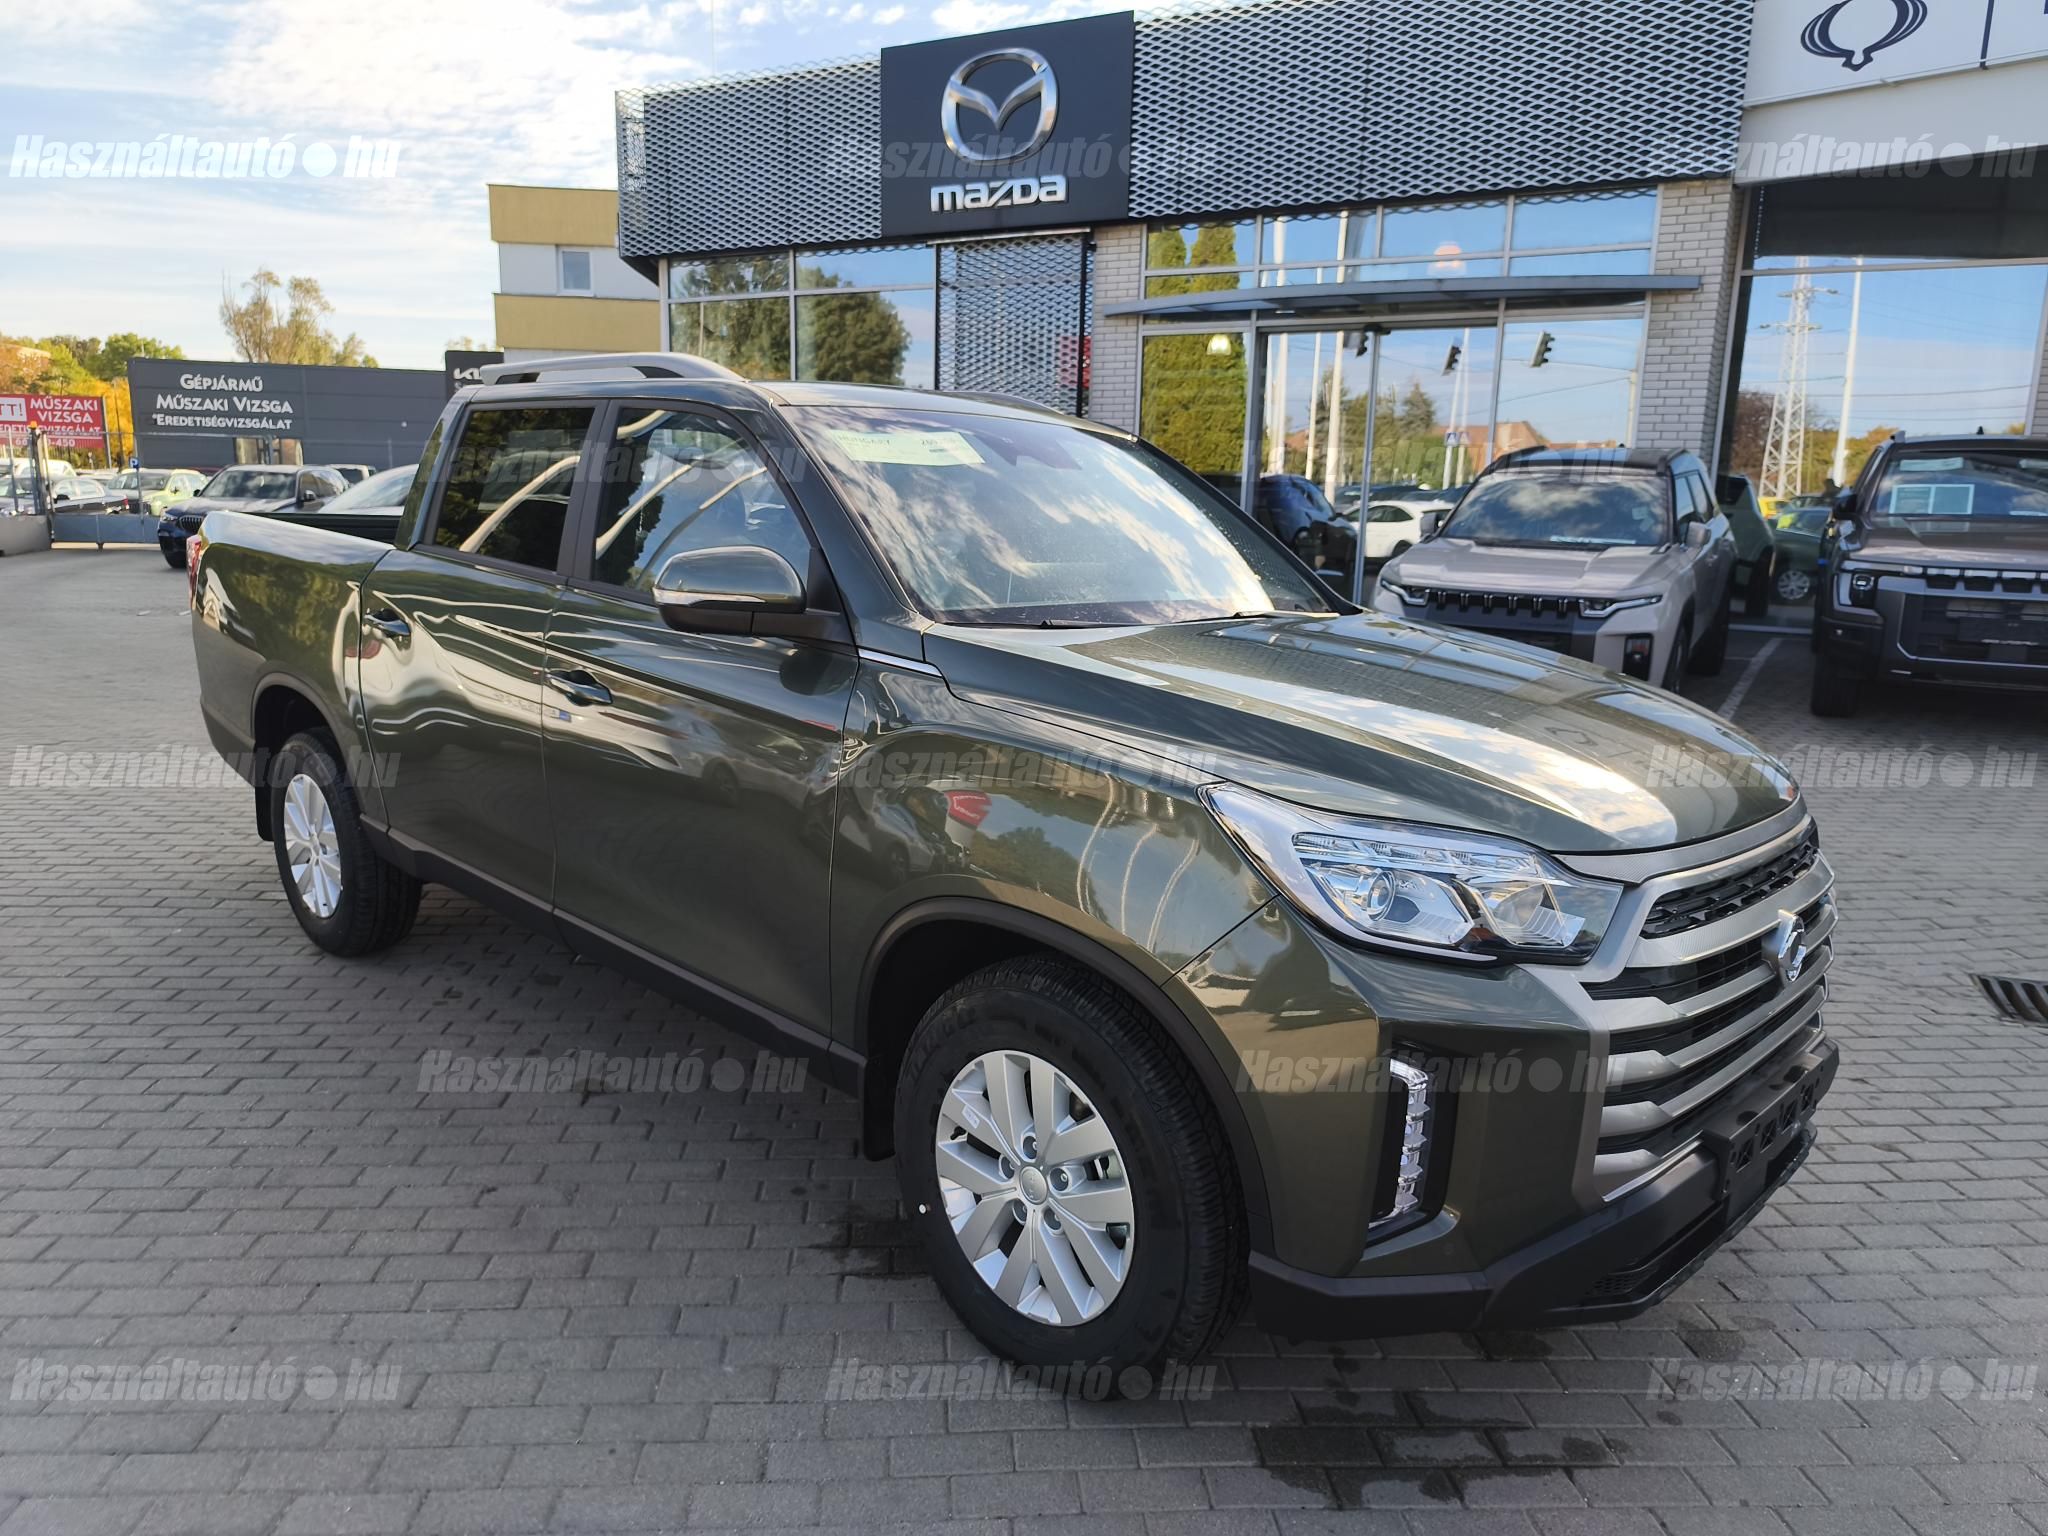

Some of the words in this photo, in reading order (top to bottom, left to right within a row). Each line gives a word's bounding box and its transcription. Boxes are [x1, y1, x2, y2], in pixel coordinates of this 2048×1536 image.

[180, 373, 263, 392] GÉPJÁRMŰ
[30, 396, 98, 411] MŰSZAKI
[156, 394, 229, 412] MŰSZAKI
[233, 396, 293, 414] VIZSGA
[37, 411, 93, 424] VIZSGA
